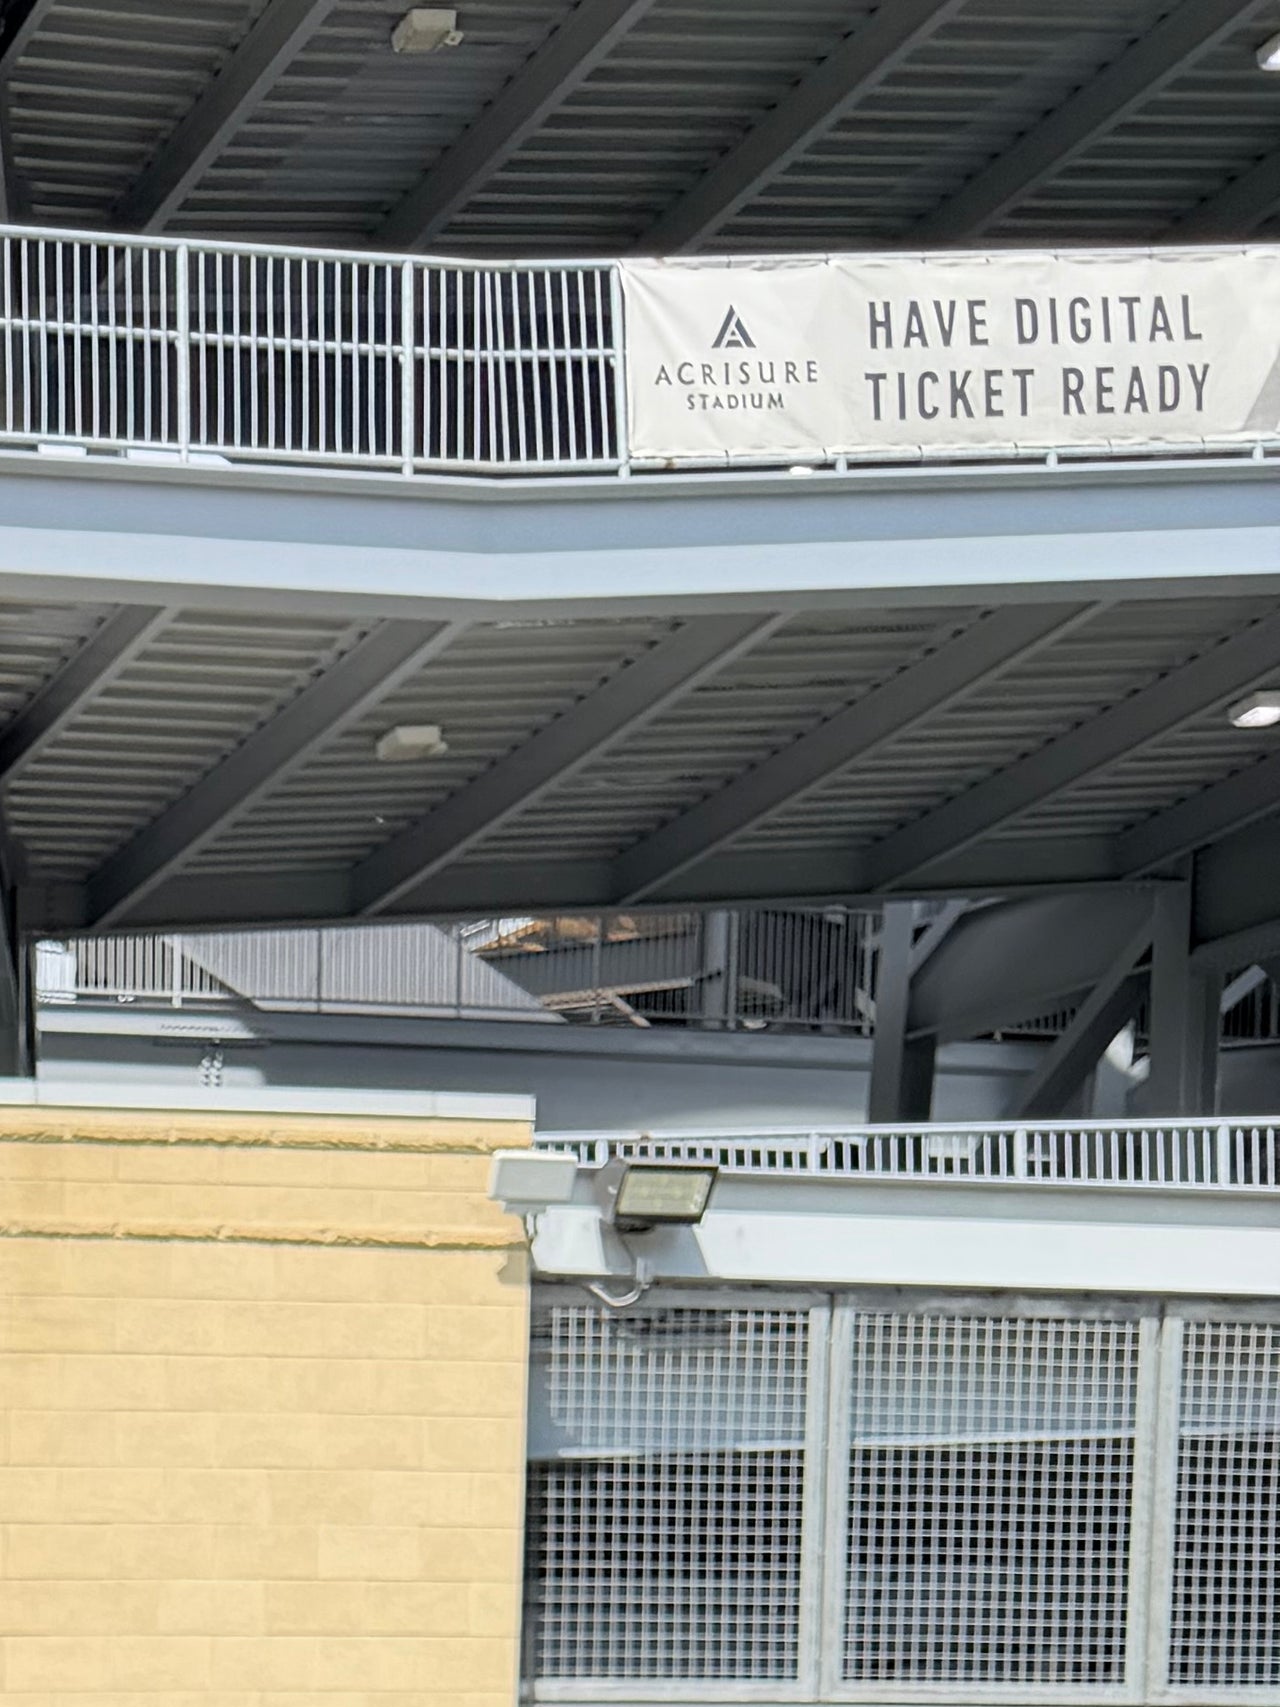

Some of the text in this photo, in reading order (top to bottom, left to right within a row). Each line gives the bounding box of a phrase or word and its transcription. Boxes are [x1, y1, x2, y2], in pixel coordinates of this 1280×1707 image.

[867, 294, 1204, 350] HAVE DIGITAL
[654, 360, 819, 386] ACRISURE
[864, 362, 1211, 421] TICKET READY
[686, 392, 785, 411] STADIUM
